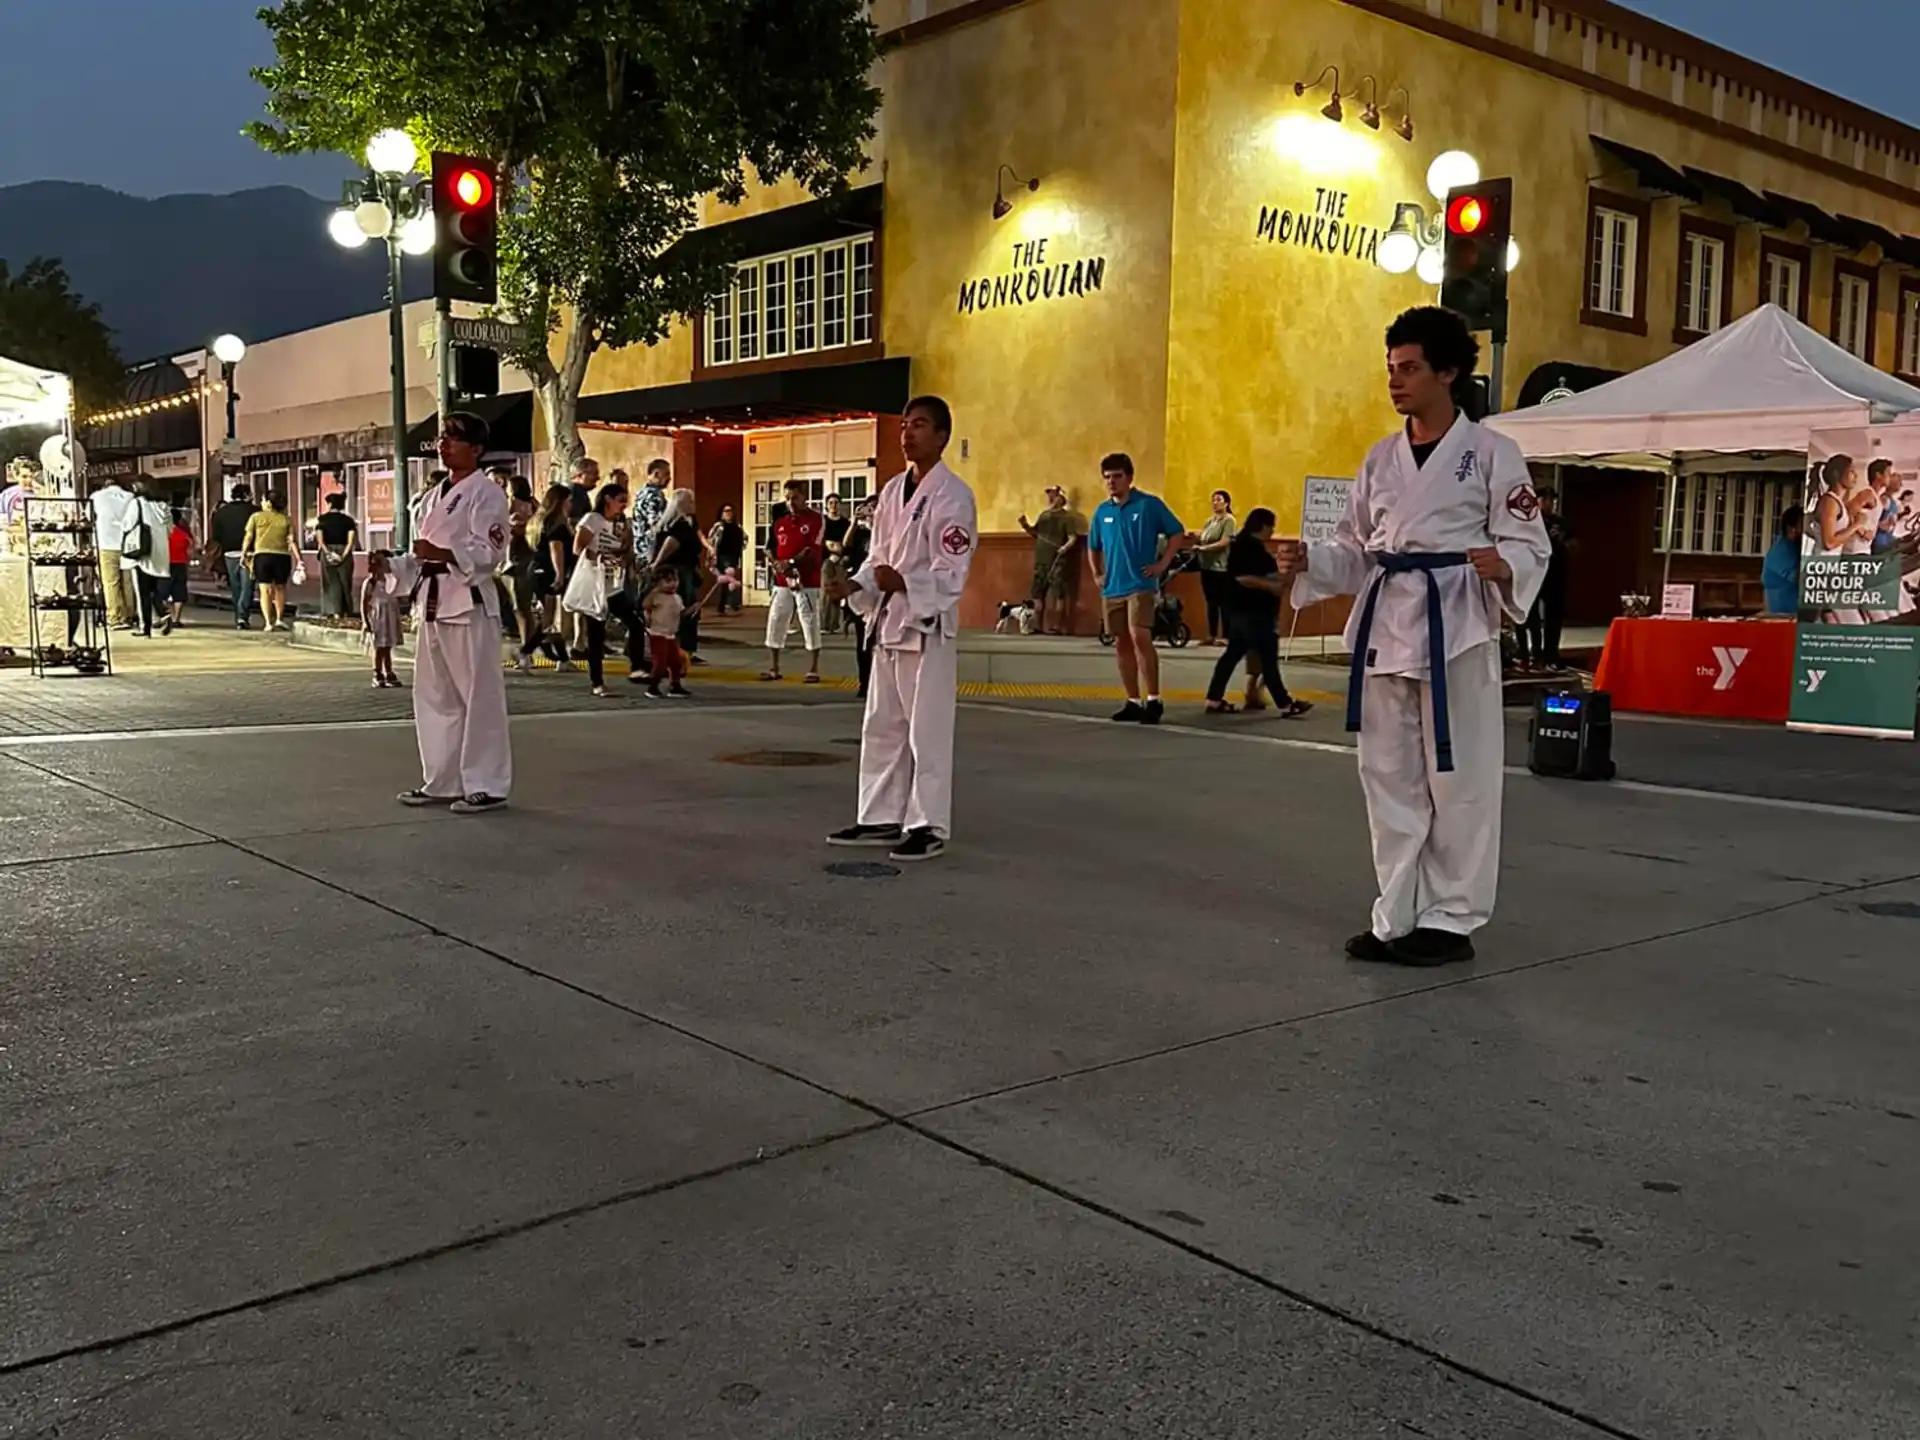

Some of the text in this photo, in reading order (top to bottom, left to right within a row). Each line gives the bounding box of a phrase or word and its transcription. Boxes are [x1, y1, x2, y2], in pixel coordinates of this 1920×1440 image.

[1316, 188, 1348, 218] THE
[1013, 238, 1048, 268] THE
[453, 320, 511, 343] COLORADO
[1806, 561, 1883, 575] COME TRY
[1805, 576, 1864, 590] ON OUR
[1804, 591, 1887, 604] NEW GEAR.
[1696, 665, 1716, 676] the
[1538, 727, 1578, 739] ION
